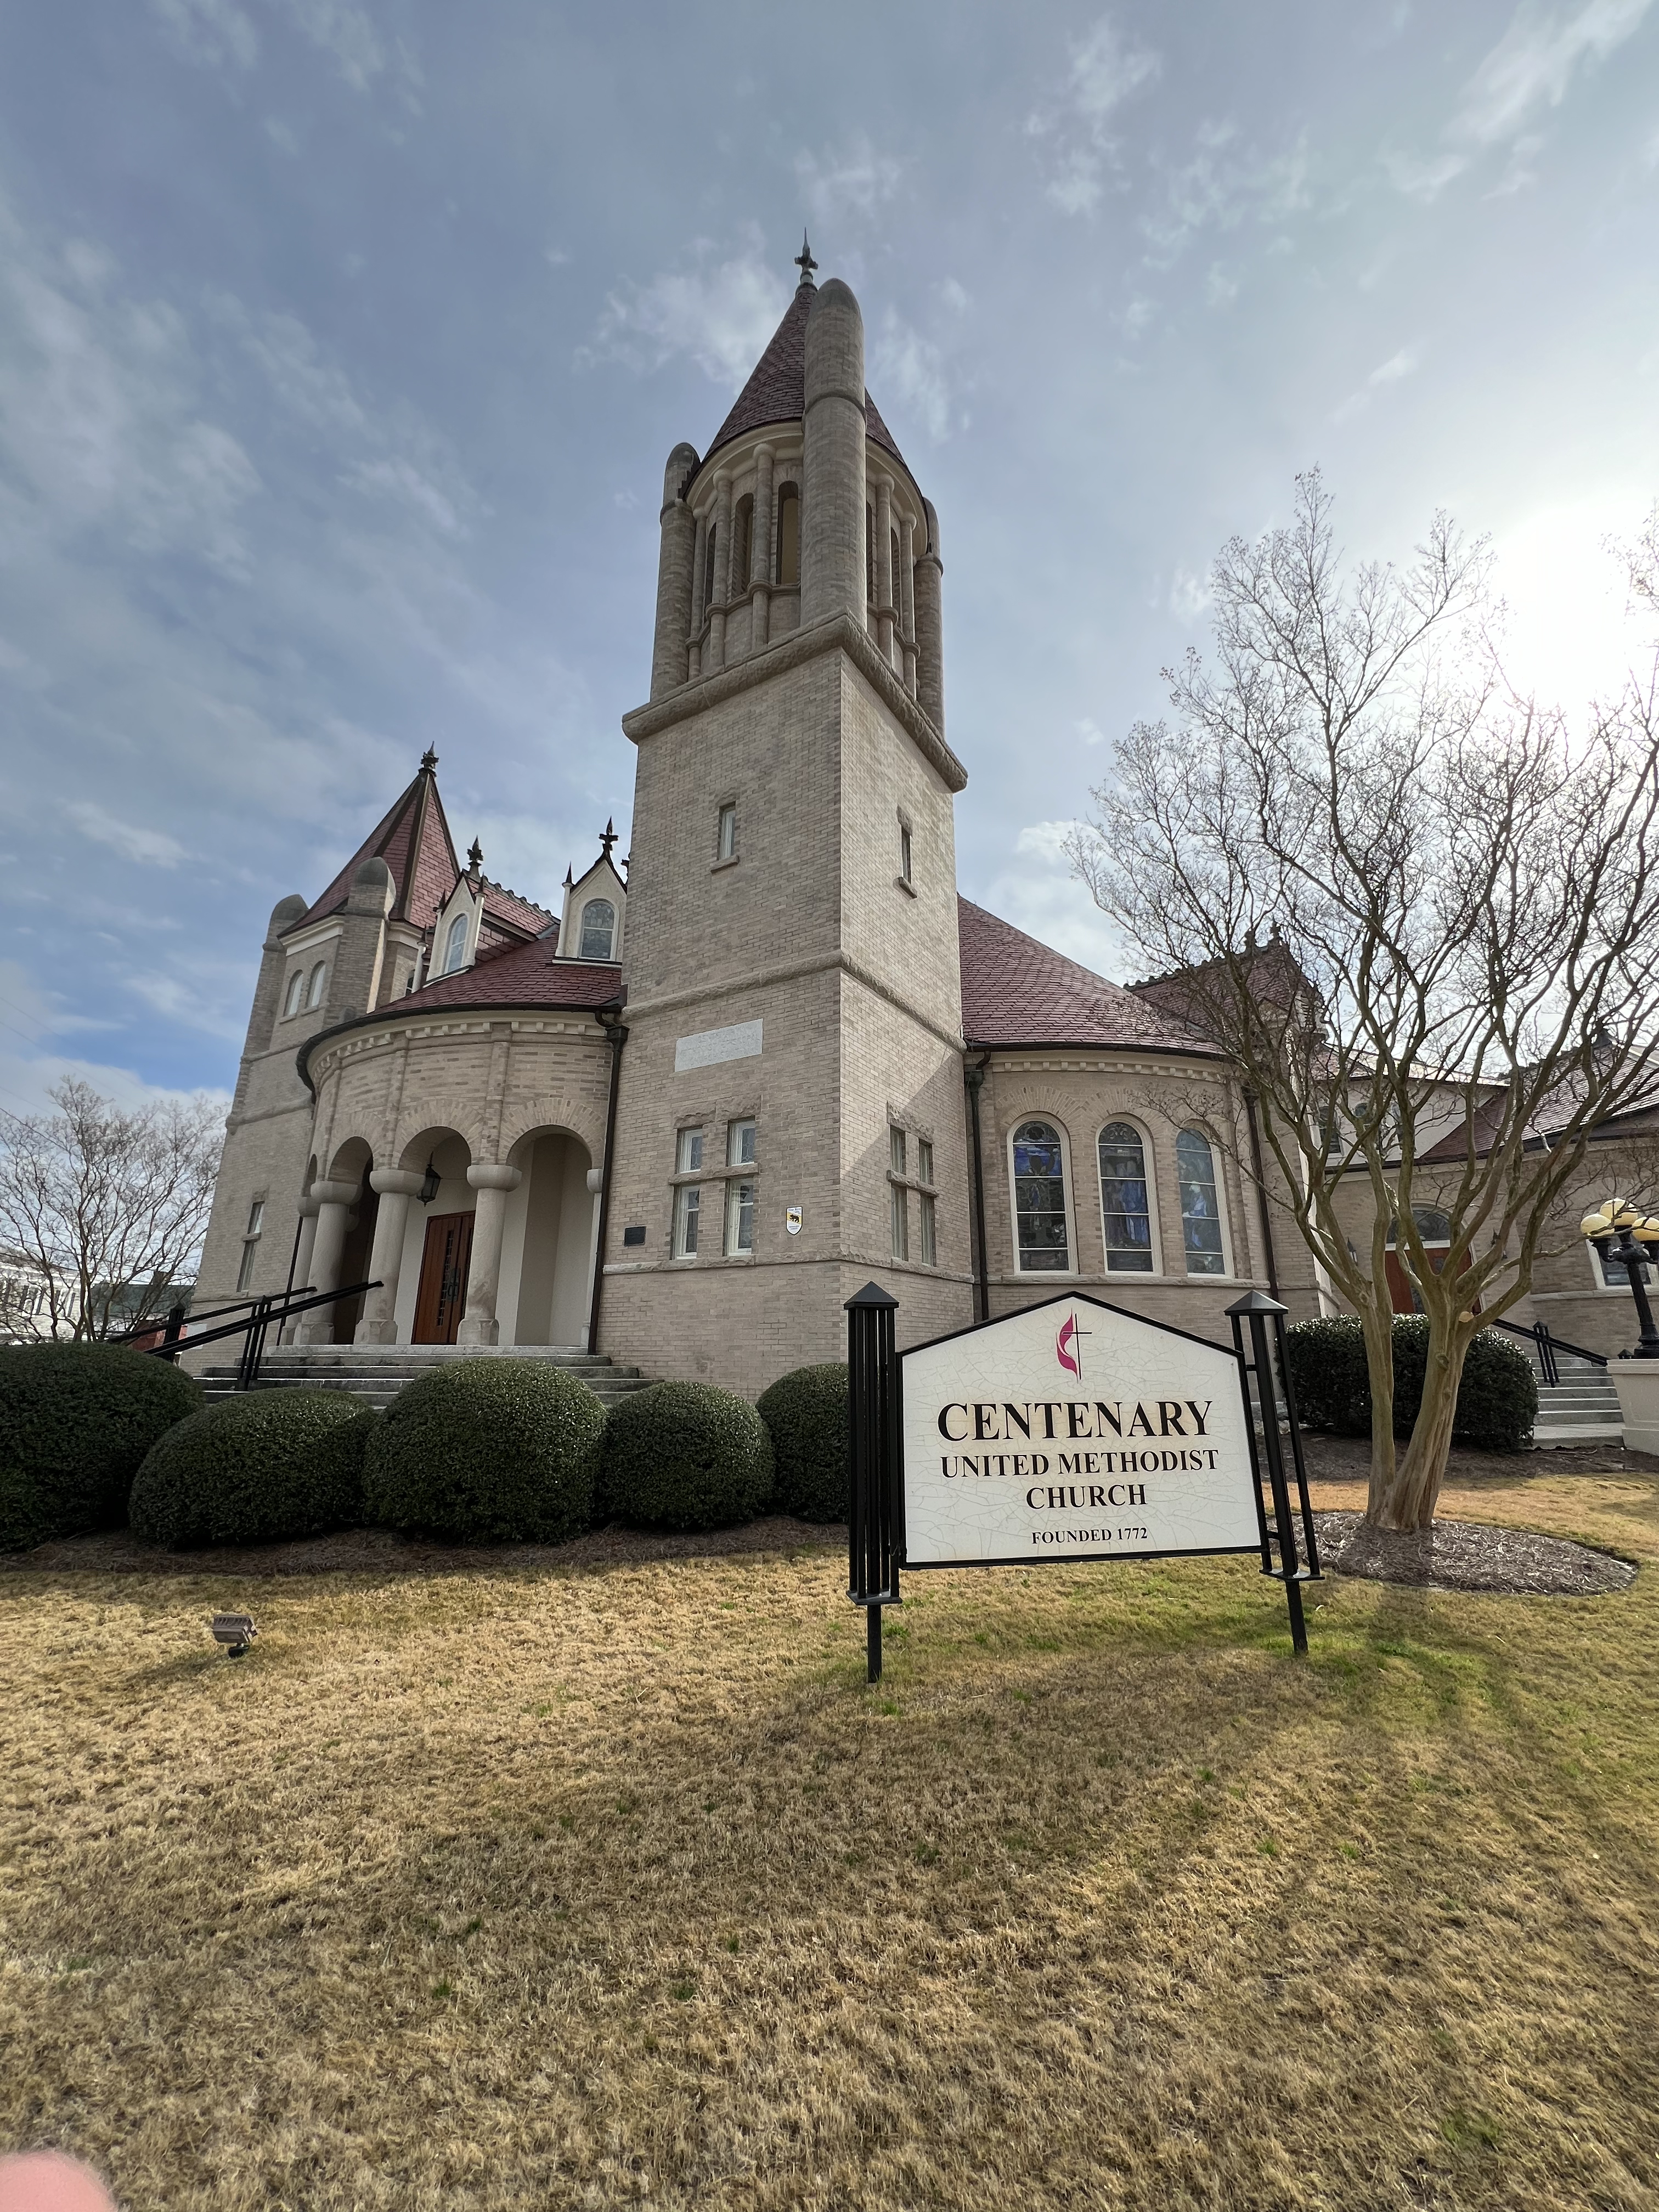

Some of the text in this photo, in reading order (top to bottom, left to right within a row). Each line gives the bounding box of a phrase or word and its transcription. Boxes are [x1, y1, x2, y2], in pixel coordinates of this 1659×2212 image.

[938, 1401, 1213, 1441] CENTENARY
[940, 1449, 1219, 1478] UNITED METHODIST
[1026, 1483, 1148, 1509] CHURCH
[1032, 1527, 1148, 1544] FOUNDED 1772
